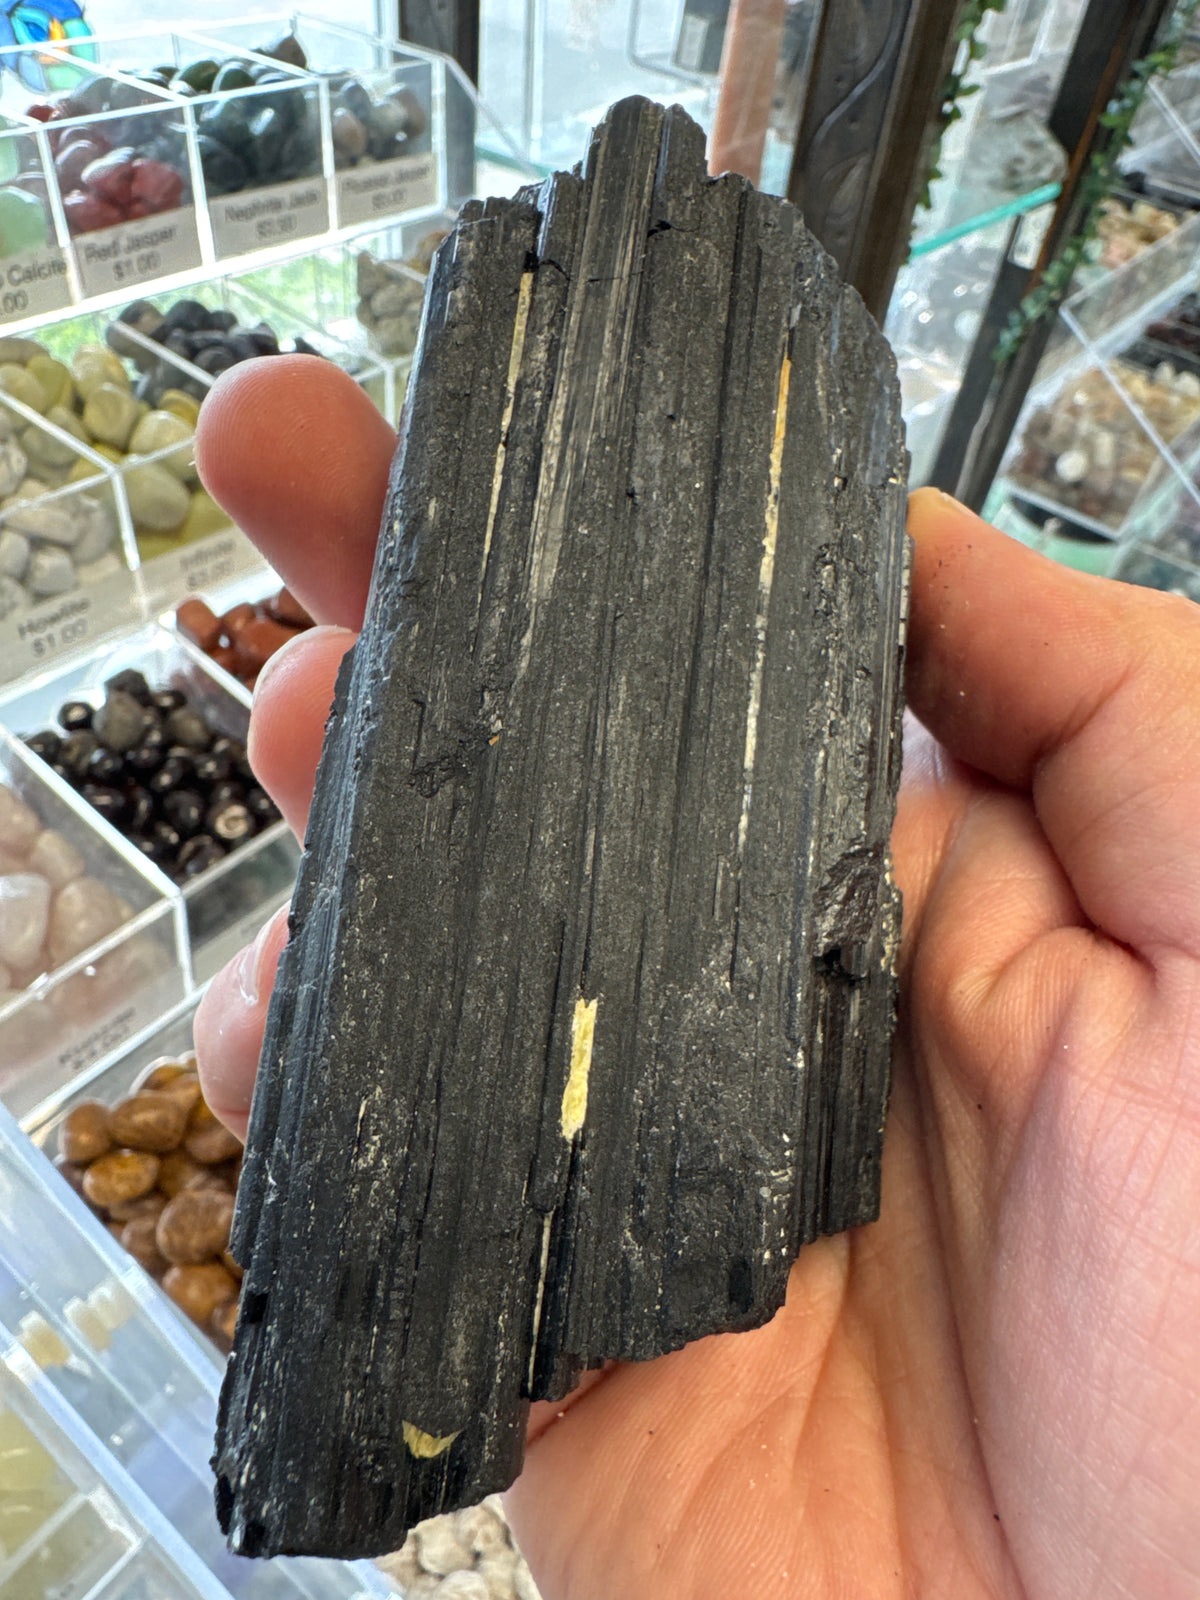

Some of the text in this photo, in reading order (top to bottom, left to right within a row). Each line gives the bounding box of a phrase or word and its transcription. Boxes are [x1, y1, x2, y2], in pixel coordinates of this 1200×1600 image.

[84, 225, 176, 265] Red Jasper
[7, 255, 67, 287] Calcite
